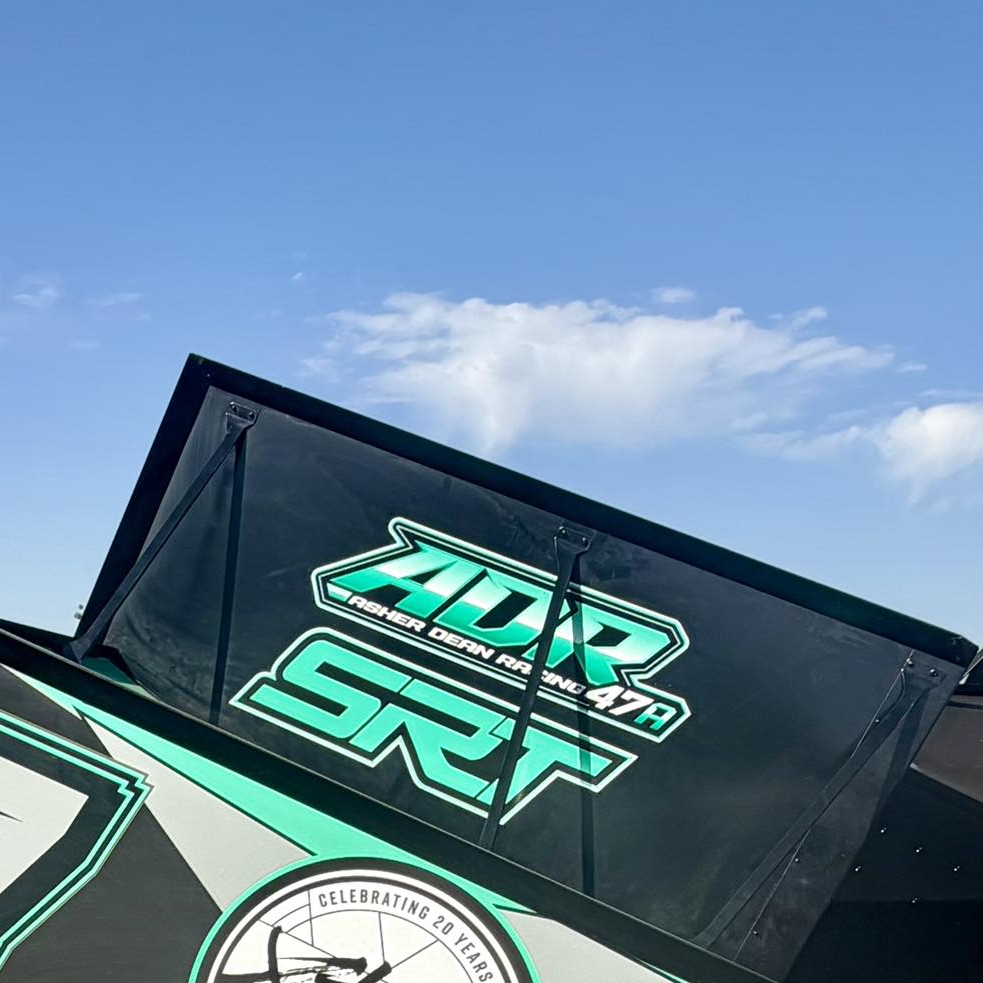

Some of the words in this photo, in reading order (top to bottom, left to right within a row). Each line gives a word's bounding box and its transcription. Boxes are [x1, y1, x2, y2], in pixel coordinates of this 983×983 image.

[328, 539, 672, 686] ADR
[347, 595, 426, 632] ASHER
[427, 626, 495, 660] DEAN
[495, 653, 587, 695] RAING
[248, 639, 614, 805] SRT
[318, 889, 429, 920] CELEBRATING
[432, 915, 454, 936] 20
[454, 933, 494, 983] YEARS
